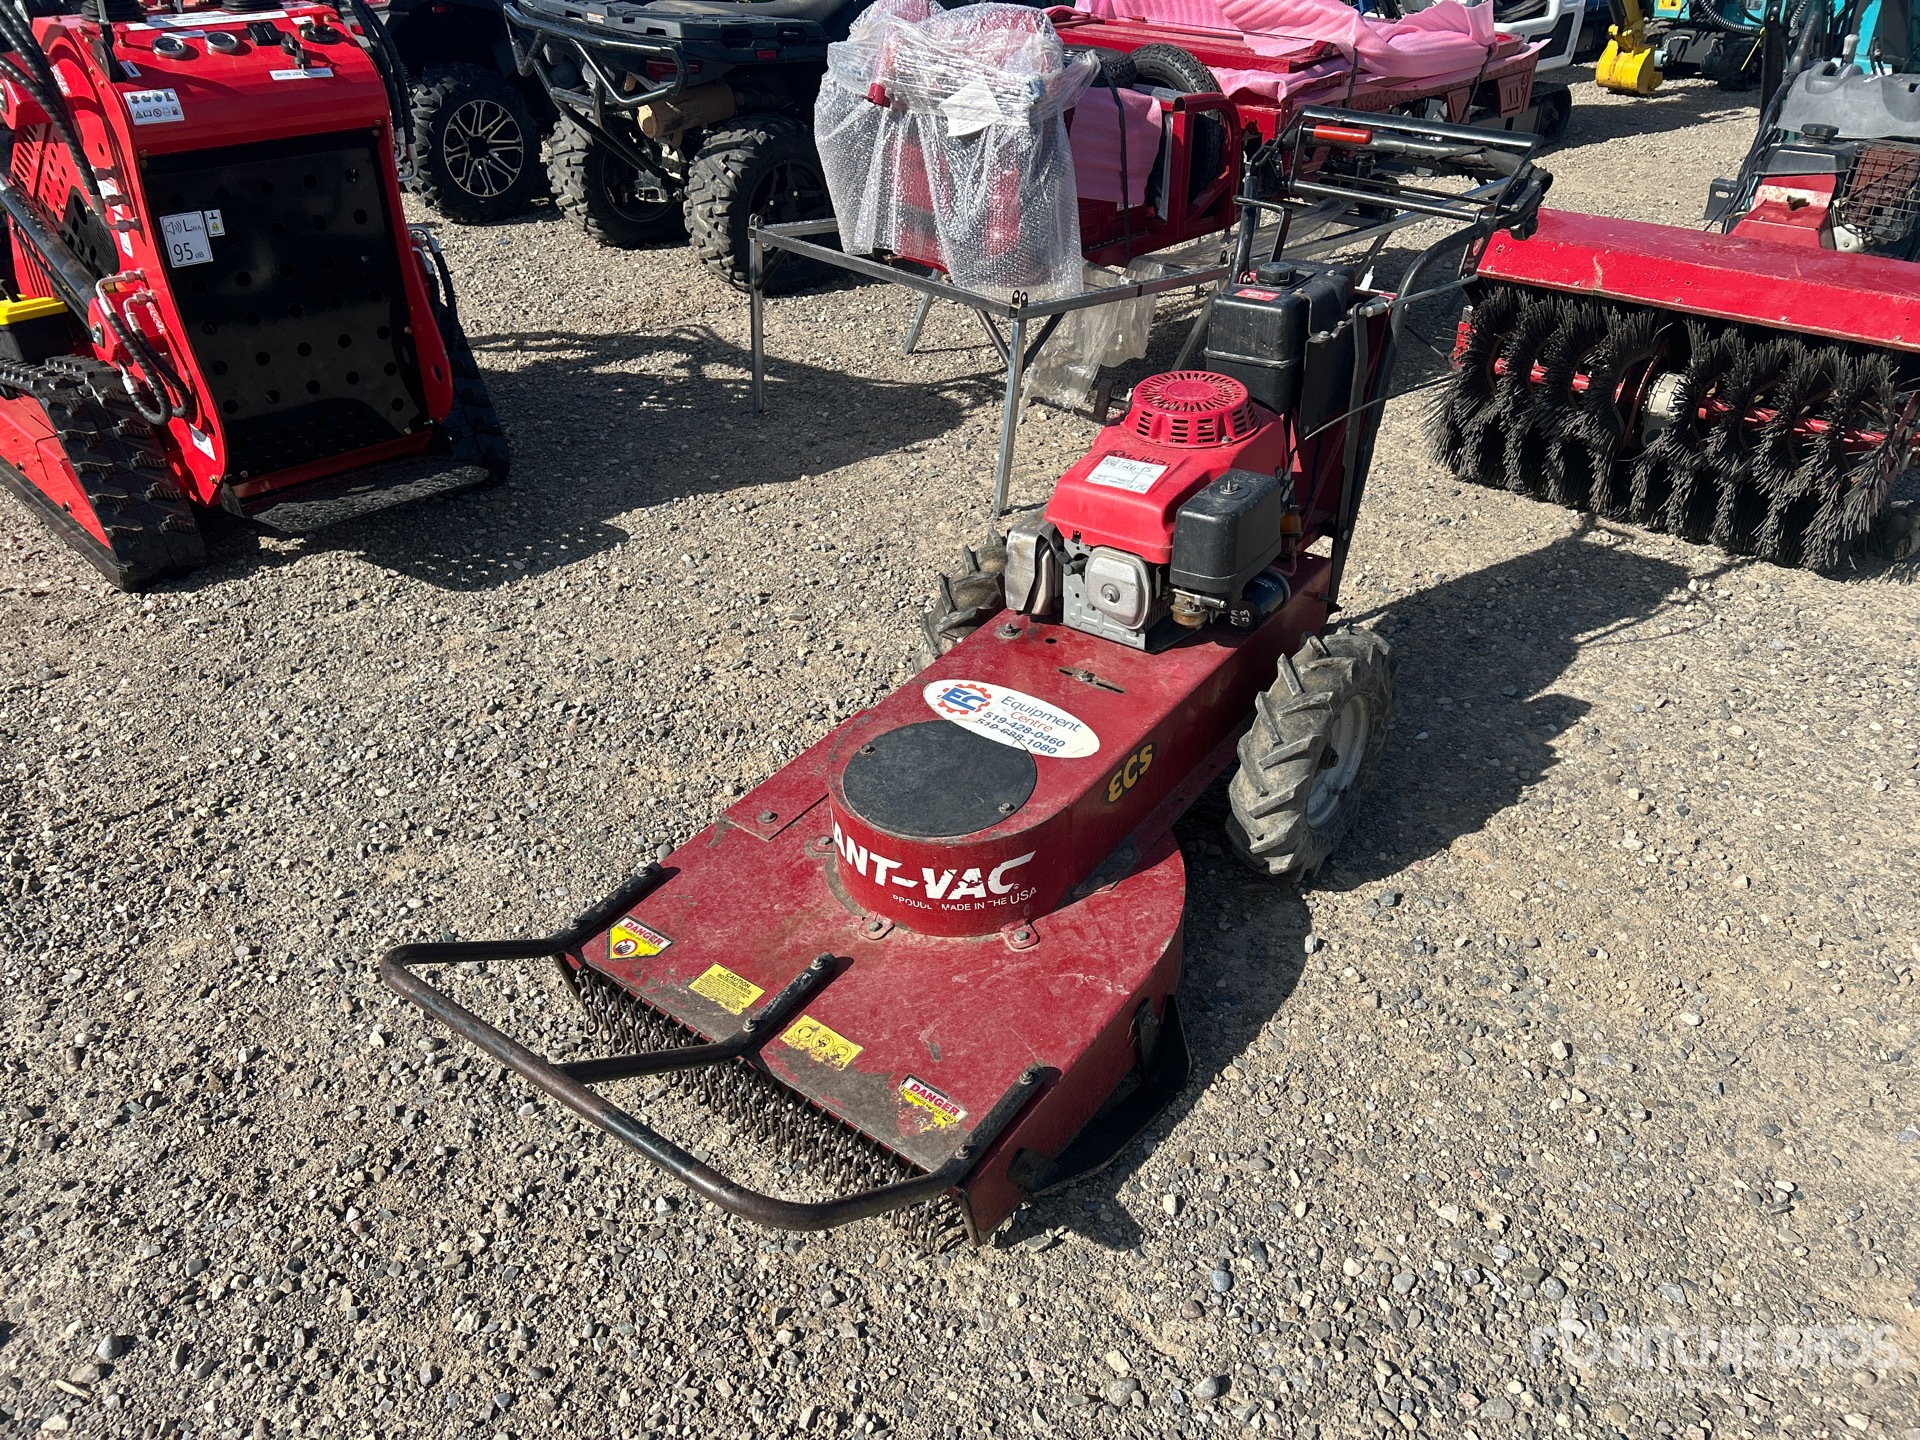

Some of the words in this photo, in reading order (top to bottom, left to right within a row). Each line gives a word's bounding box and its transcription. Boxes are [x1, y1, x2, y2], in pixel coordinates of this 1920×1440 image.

[173, 242, 194, 262] 95
[194, 251, 205, 259] dB
[1000, 695, 1083, 733] Equipment
[1009, 711, 1053, 733] Centre
[983, 711, 1066, 748] 519-428-0460
[1108, 744, 1153, 802] ECS
[941, 903, 971, 911] MADE
[974, 902, 985, 910] IN
[1010, 886, 1037, 905] USA
[624, 921, 664, 945] DANGER
[725, 972, 752, 989] CAUTION
[909, 1083, 960, 1117] DANGER
